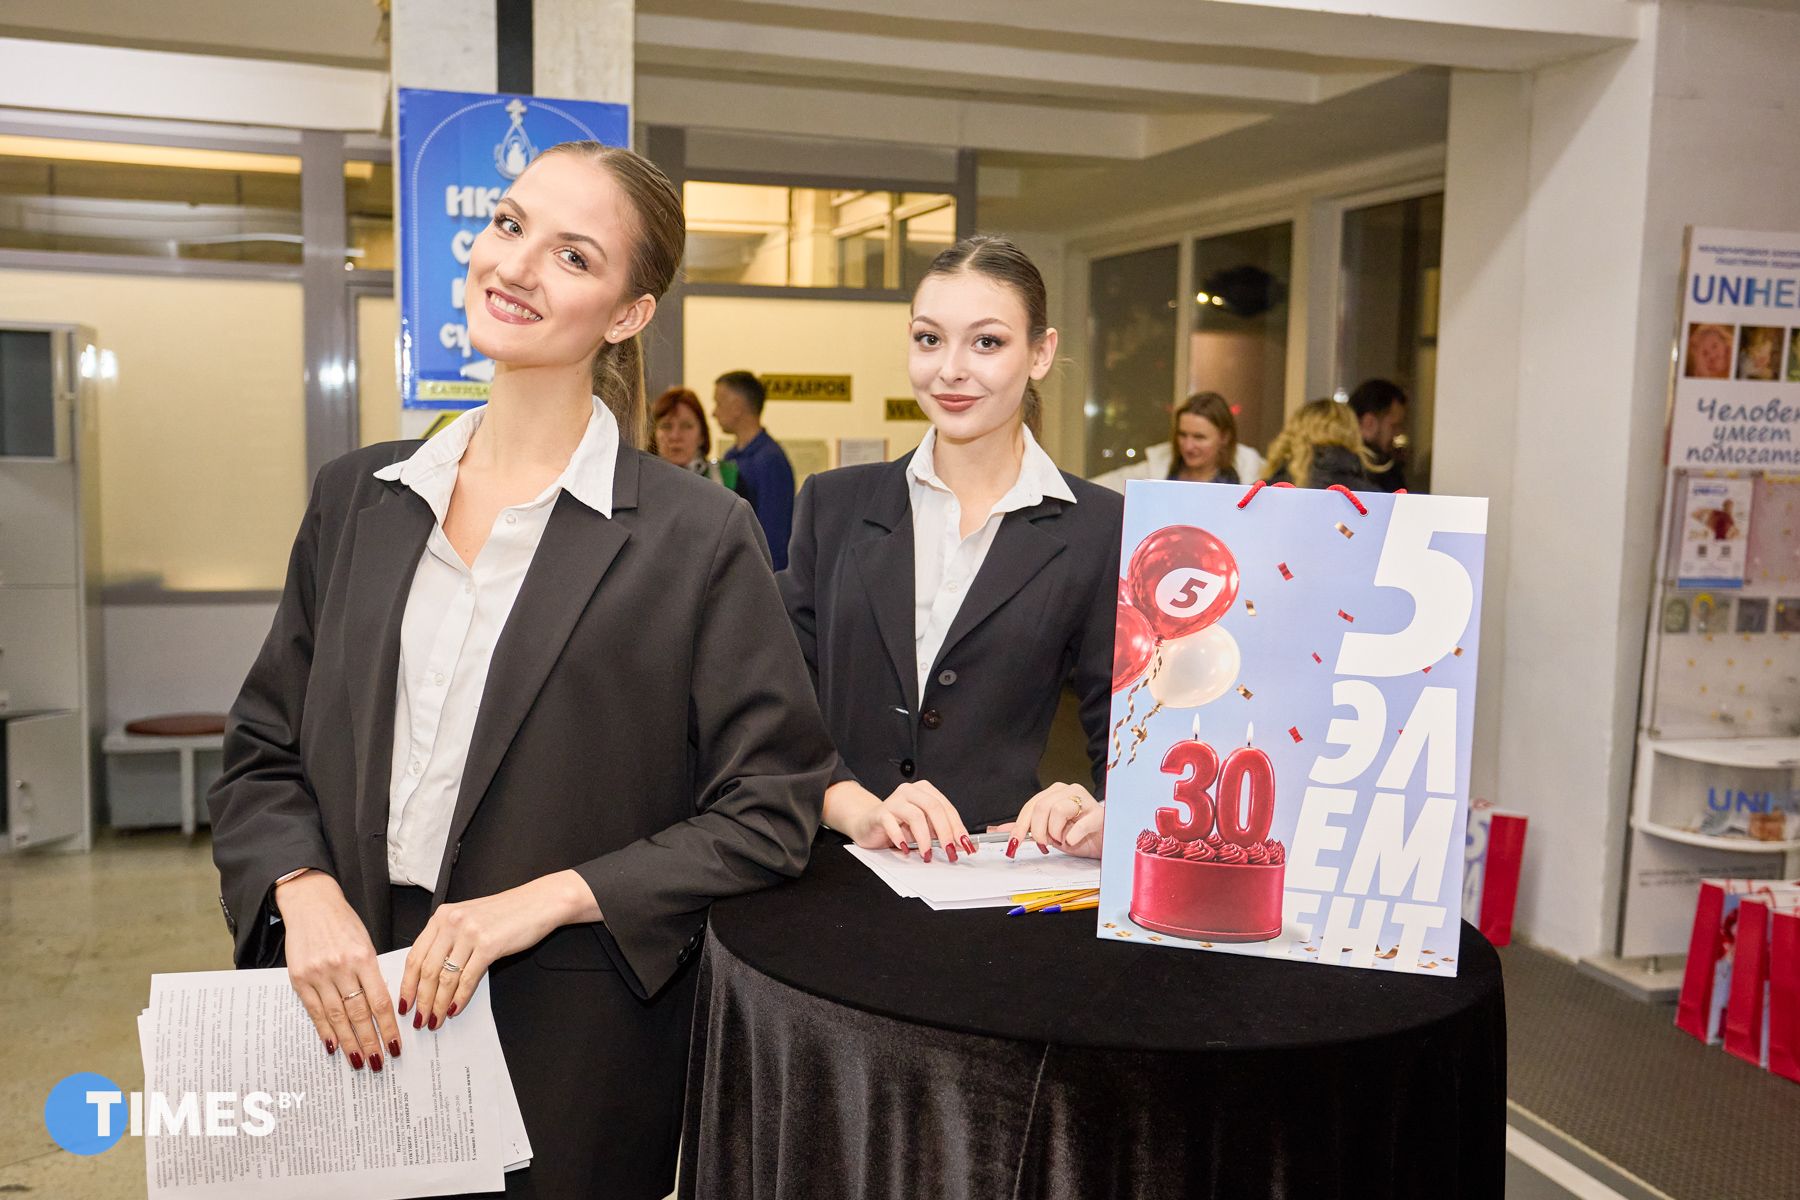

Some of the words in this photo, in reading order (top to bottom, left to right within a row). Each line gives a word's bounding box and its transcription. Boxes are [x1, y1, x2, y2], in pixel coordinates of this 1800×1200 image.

[1692, 273, 1800, 309] UNIHE
[1712, 425, 1791, 449] умеет
[1169, 576, 1208, 609] 5
[1334, 494, 1488, 678] 5
[1308, 680, 1458, 794] ЭЛ
[1155, 738, 1276, 848] 30
[1285, 786, 1456, 902] ЕМ
[1283, 891, 1447, 973] ЕНТ
